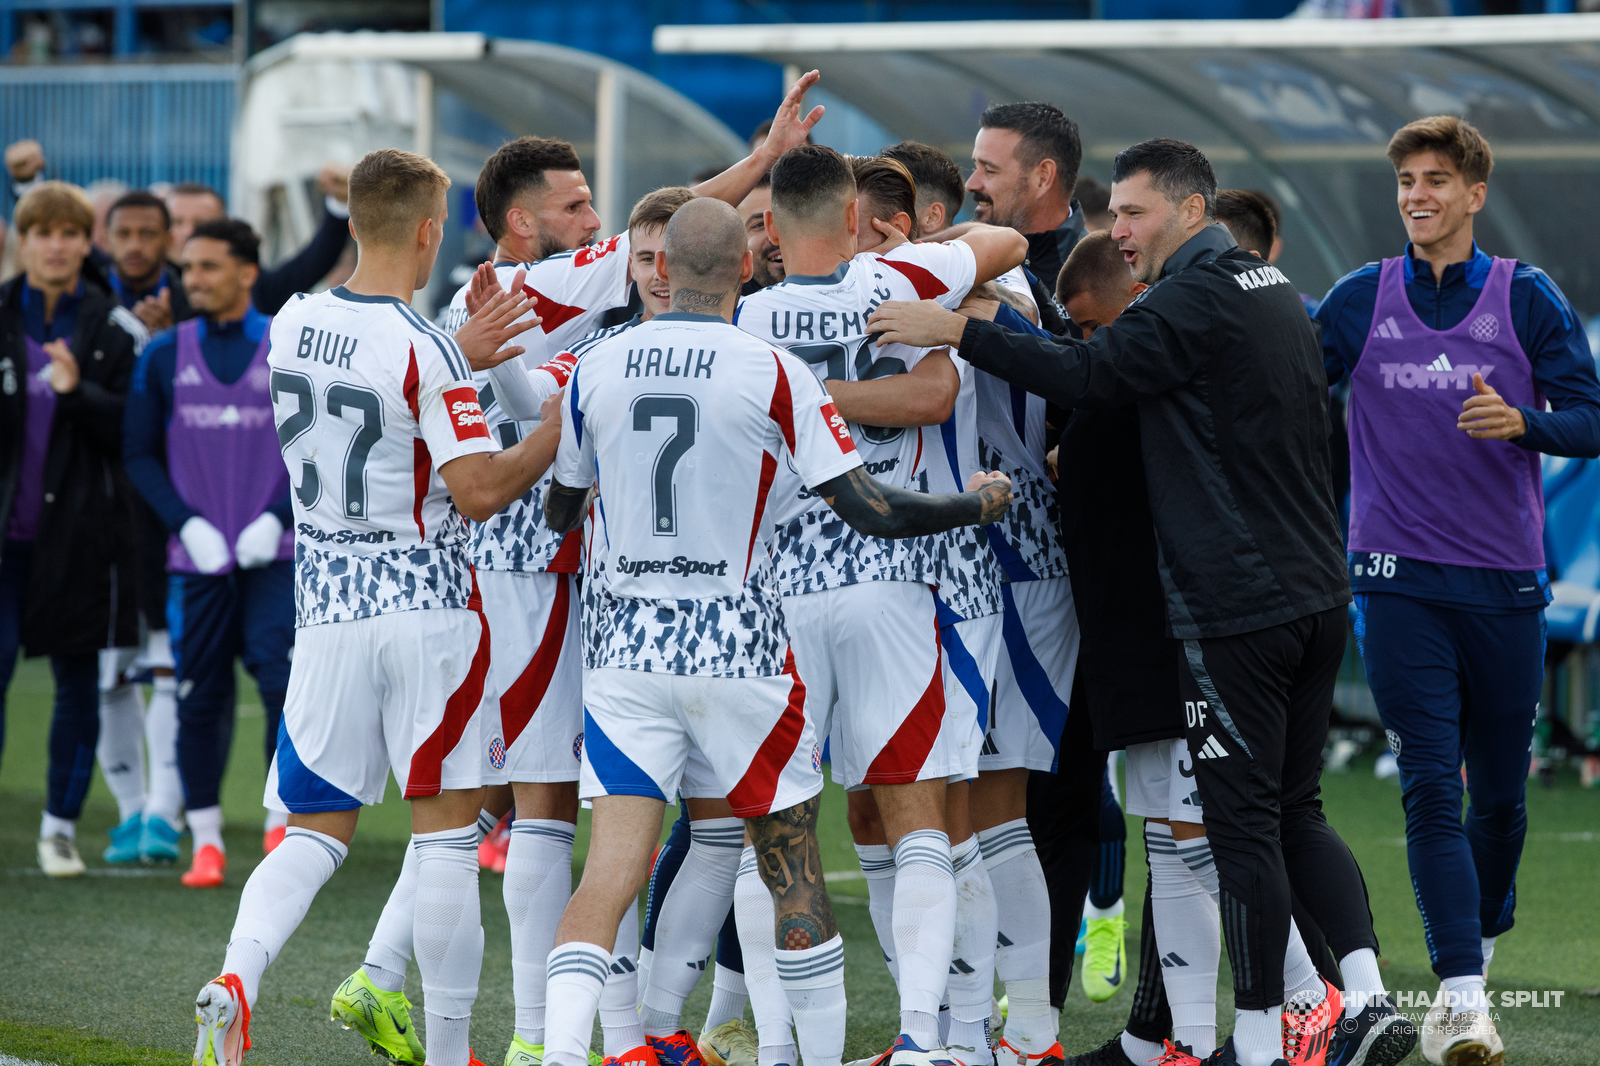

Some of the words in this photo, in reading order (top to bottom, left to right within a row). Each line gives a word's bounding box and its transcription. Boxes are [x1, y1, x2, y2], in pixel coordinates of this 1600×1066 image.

[297, 326, 358, 370] BIUK
[624, 347, 717, 379] KALIK
[1379, 362, 1496, 390] TOMMY
[629, 393, 700, 537] 7
[616, 555, 728, 578] SuperSport
[1367, 552, 1398, 579] 36
[1185, 701, 1208, 728] DF
